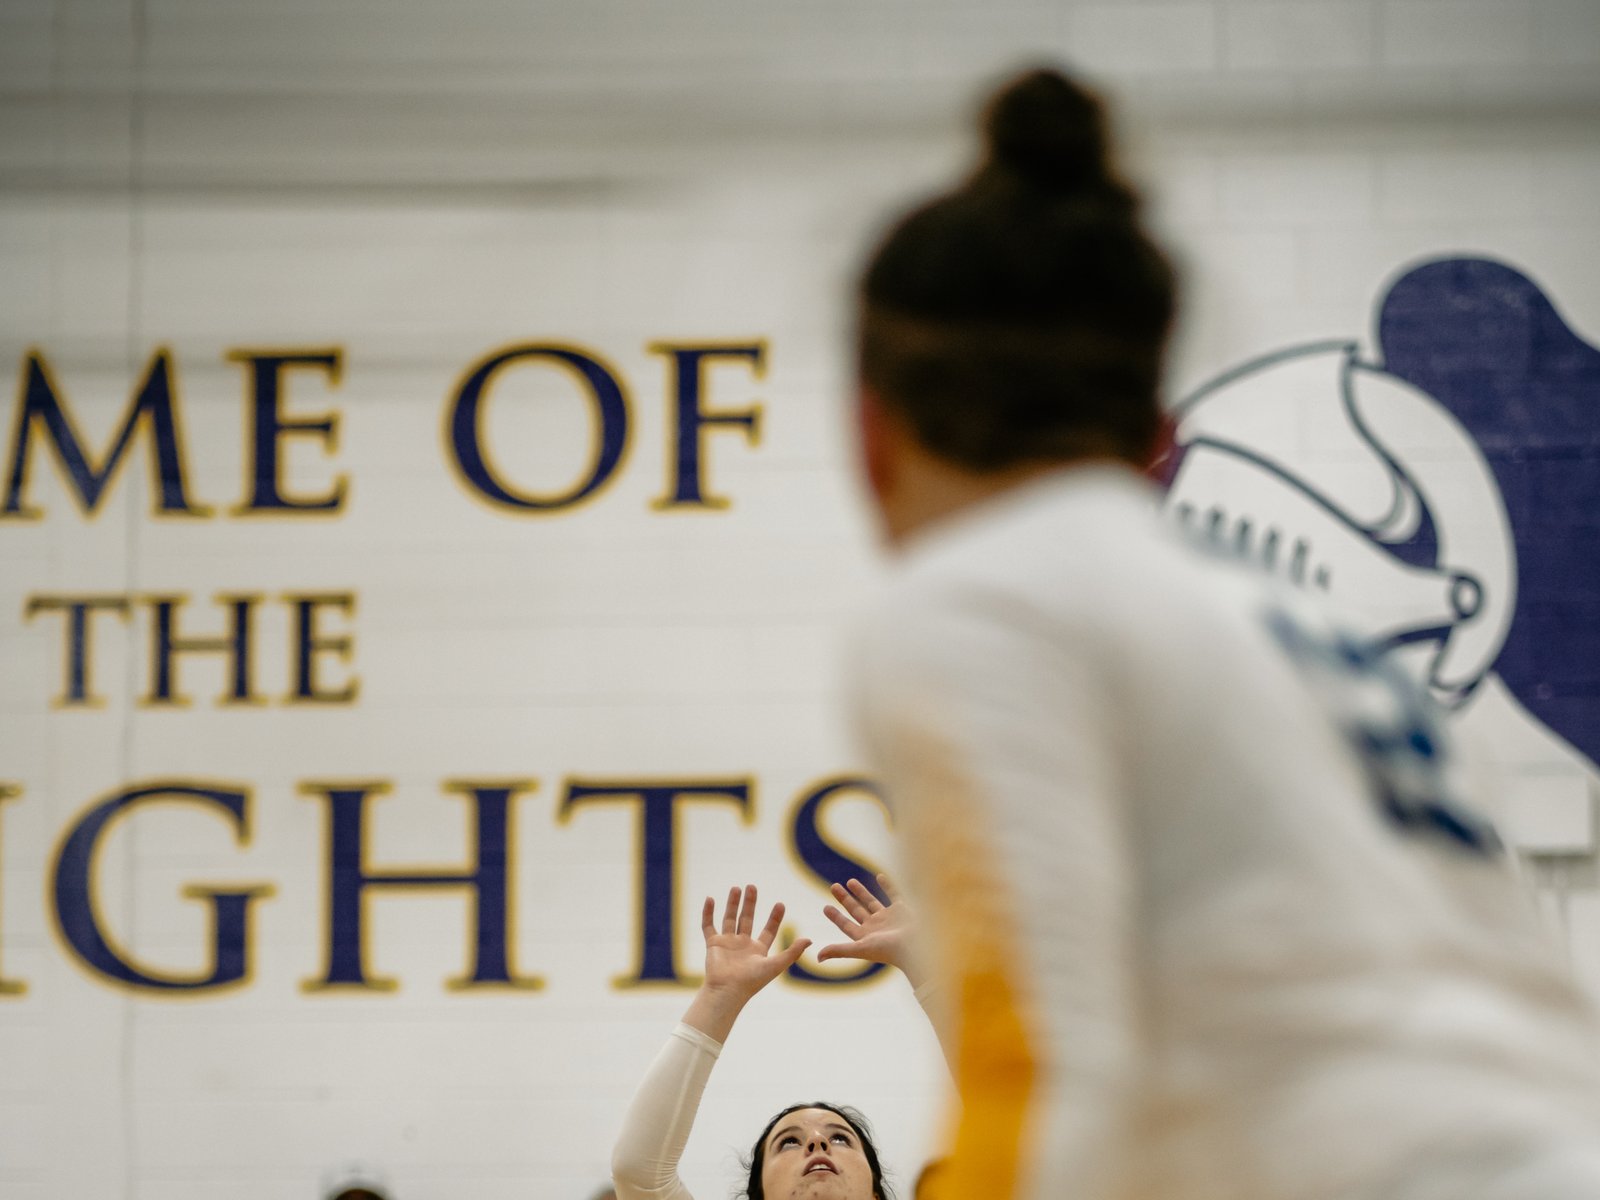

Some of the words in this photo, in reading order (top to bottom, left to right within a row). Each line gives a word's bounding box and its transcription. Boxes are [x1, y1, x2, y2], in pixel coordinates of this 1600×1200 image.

[441, 339, 769, 519] OF
[23, 591, 360, 708] THE
[0, 774, 896, 998] GHTS
